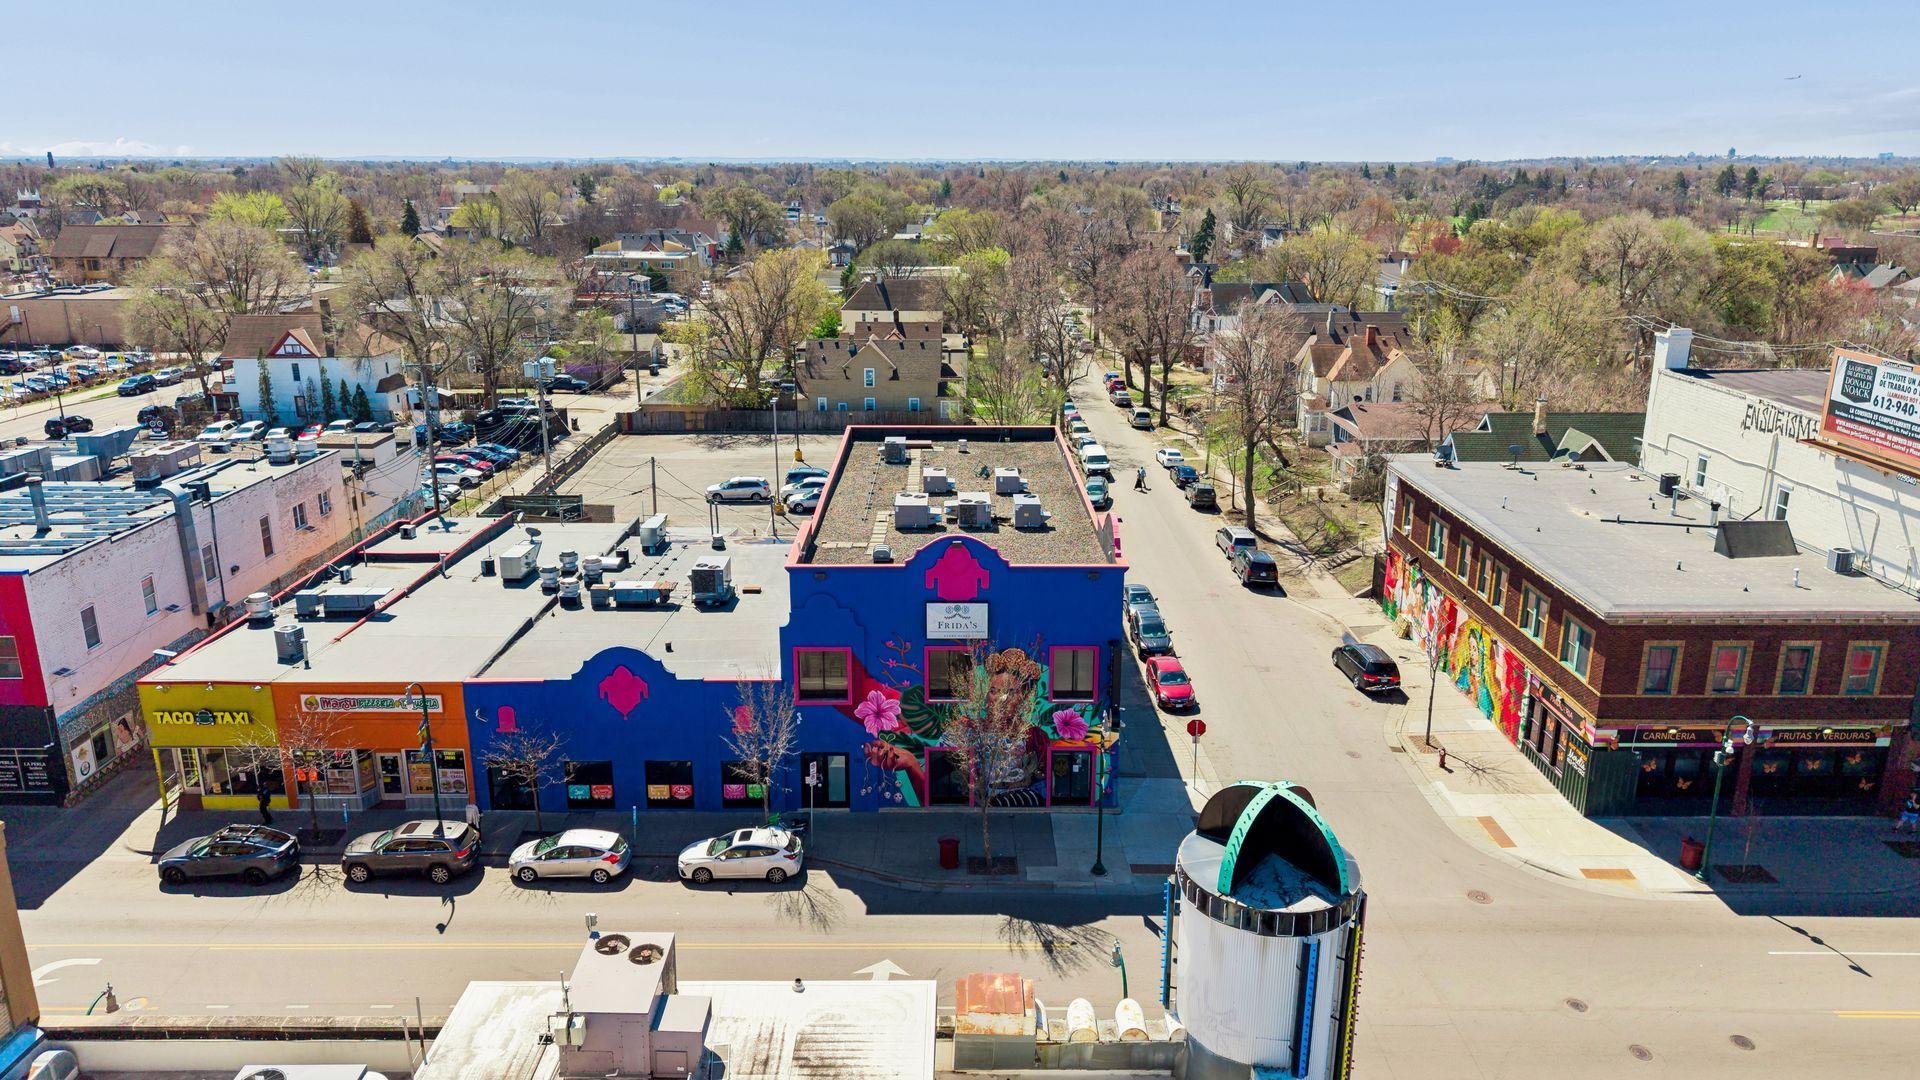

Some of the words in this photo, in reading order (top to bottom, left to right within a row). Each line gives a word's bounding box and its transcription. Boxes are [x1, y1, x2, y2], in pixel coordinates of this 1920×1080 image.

[1845, 377, 1872, 390] DONALD
[1883, 371, 1907, 383] ¿TUVISTE
[1908, 377, 1917, 385] UN
[1843, 384, 1870, 399] NOACK
[1879, 380, 1886, 388] DE
[1887, 382, 1912, 394] TRABAJO
[1873, 394, 1918, 416] 612-940-
[938, 621, 978, 629] FRIDA'S
[357, 698, 394, 709] PIZZERIA
[153, 711, 195, 724] TACO
[214, 711, 249, 724] TAXI
[1778, 731, 1811, 739] FRUTAS
[1814, 731, 1820, 739] Y
[1822, 731, 1871, 740] VERDURAS
